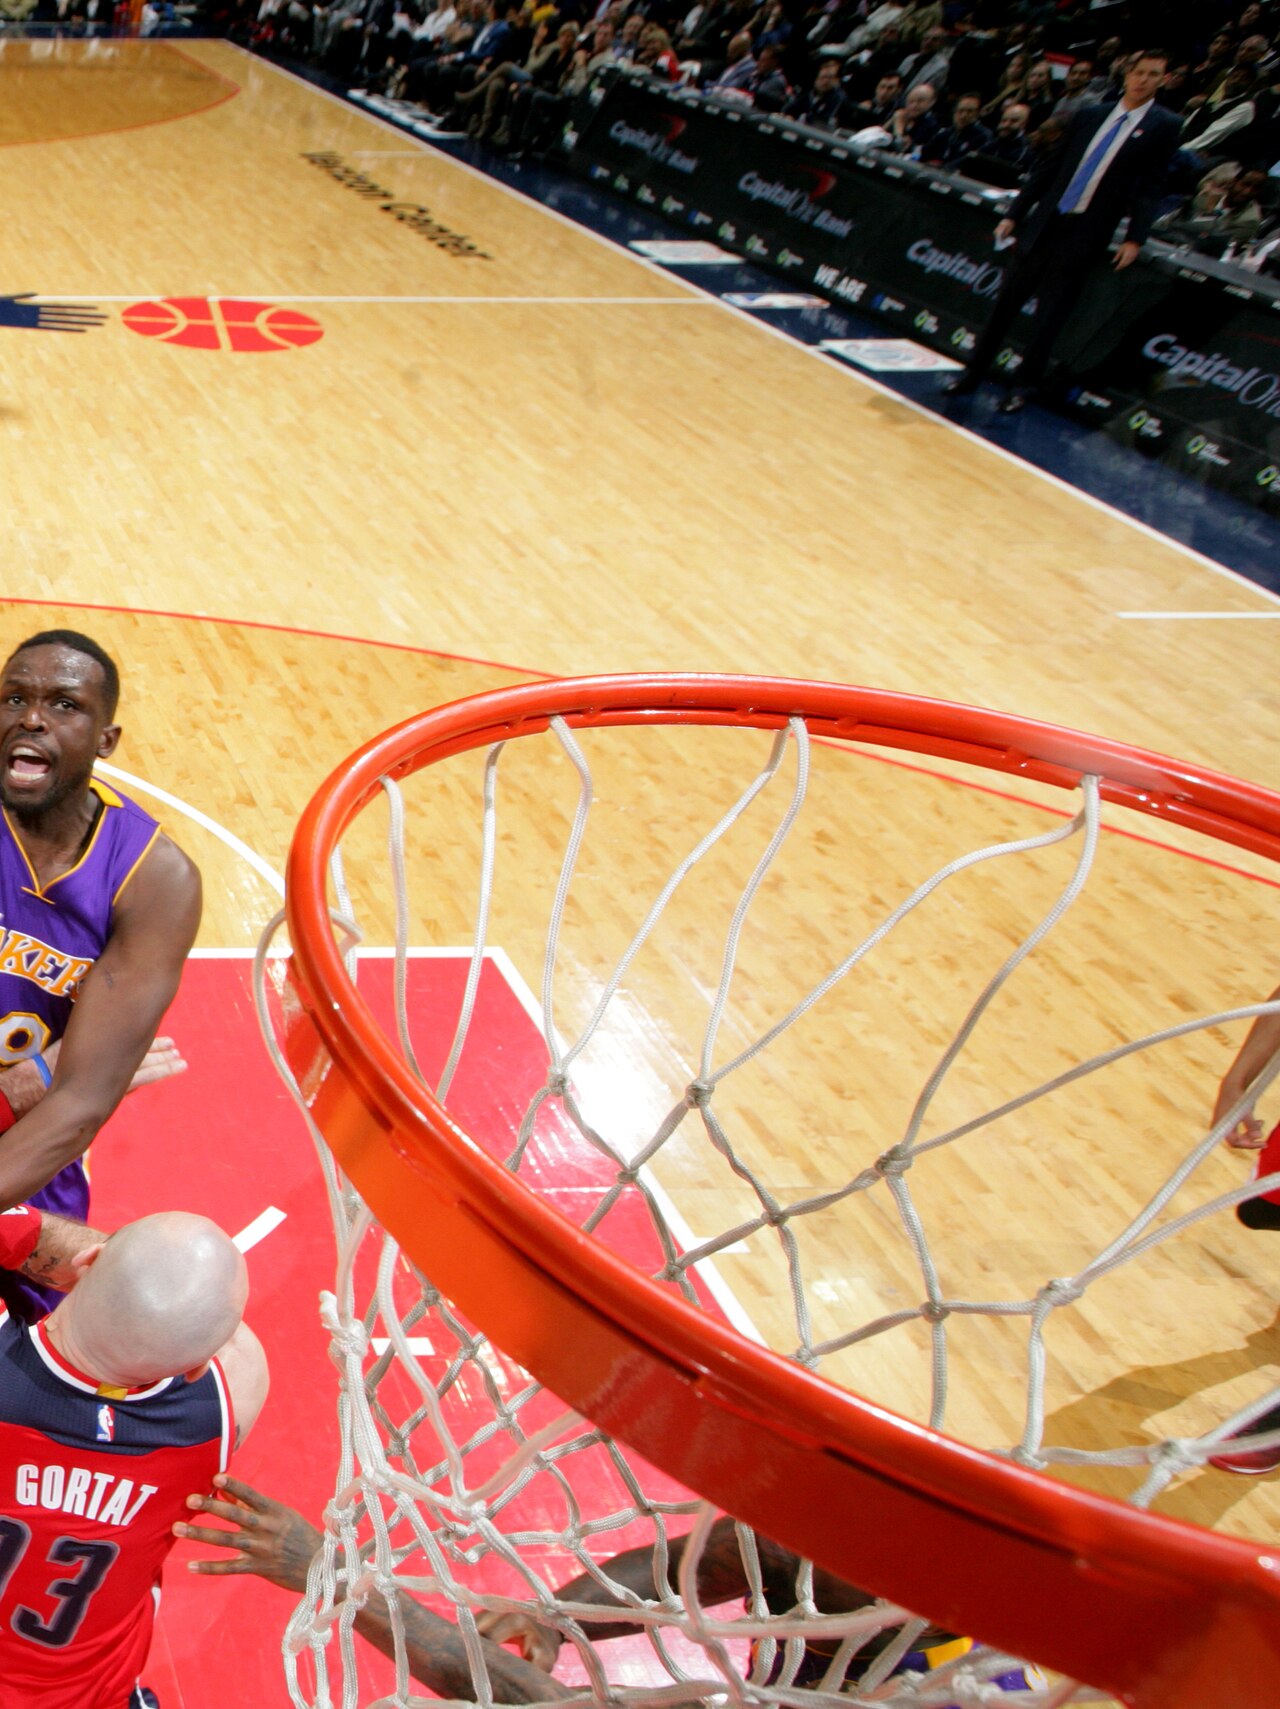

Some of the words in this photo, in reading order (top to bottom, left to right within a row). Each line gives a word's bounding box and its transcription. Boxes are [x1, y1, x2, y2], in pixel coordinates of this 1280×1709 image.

[814, 263, 840, 290] WE
[834, 276, 868, 303] ARE
[16, 1464, 159, 1527] GORTAT
